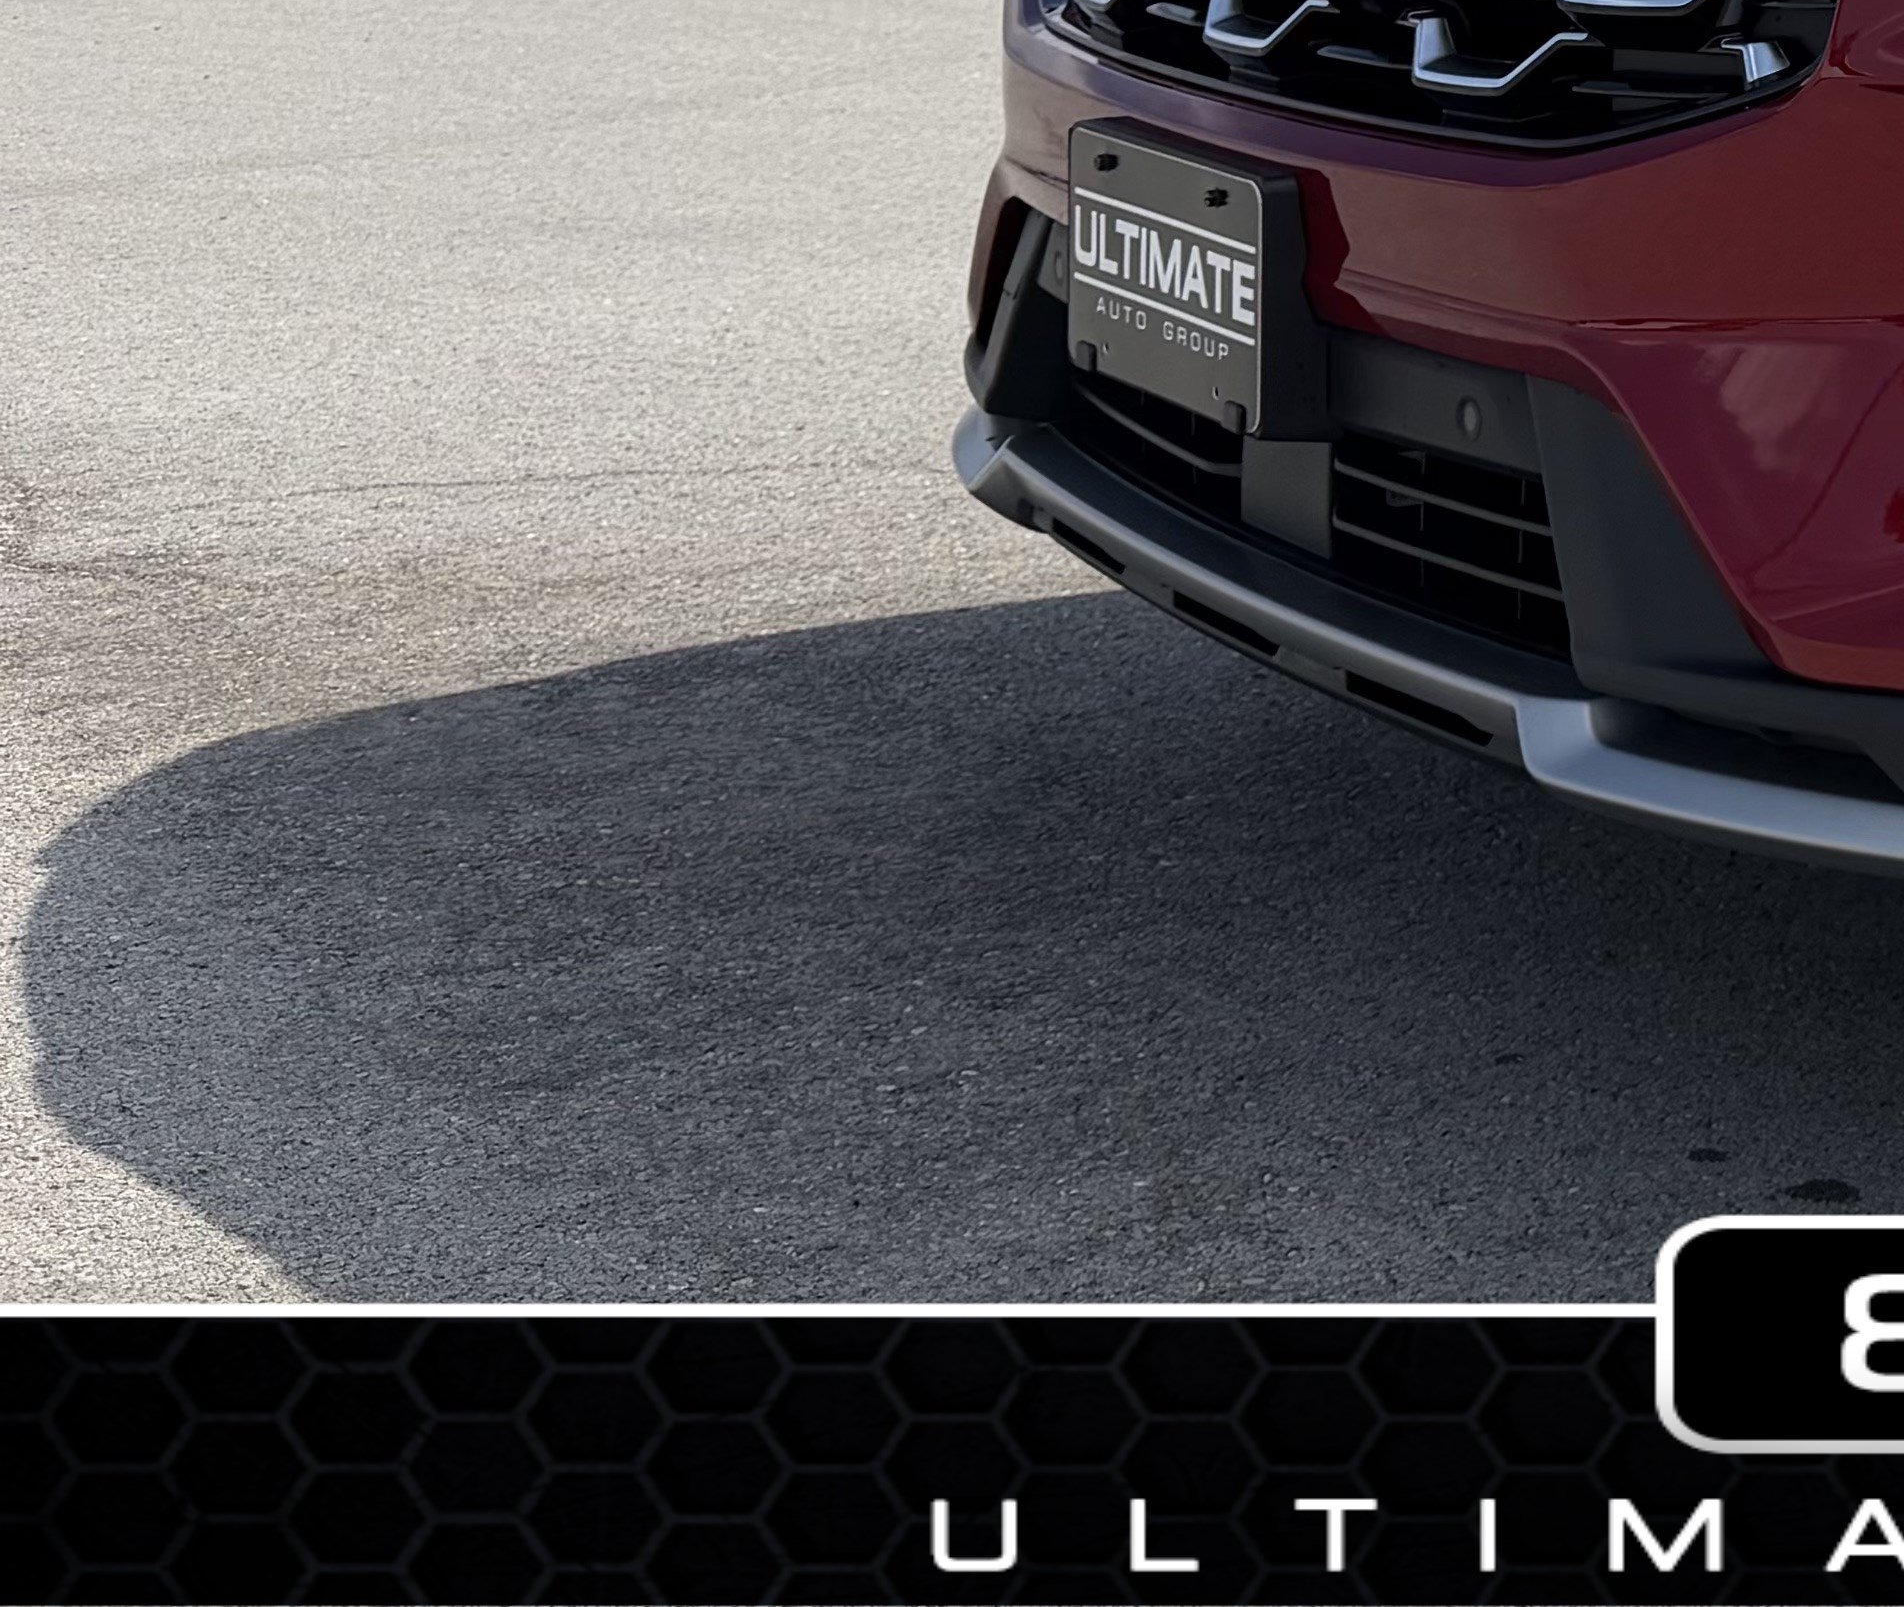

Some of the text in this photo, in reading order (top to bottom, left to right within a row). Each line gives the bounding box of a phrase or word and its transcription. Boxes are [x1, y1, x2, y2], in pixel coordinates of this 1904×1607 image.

[1074, 204, 1257, 325] ULTIMATE
[1096, 296, 1230, 361] AUTO GROUP
